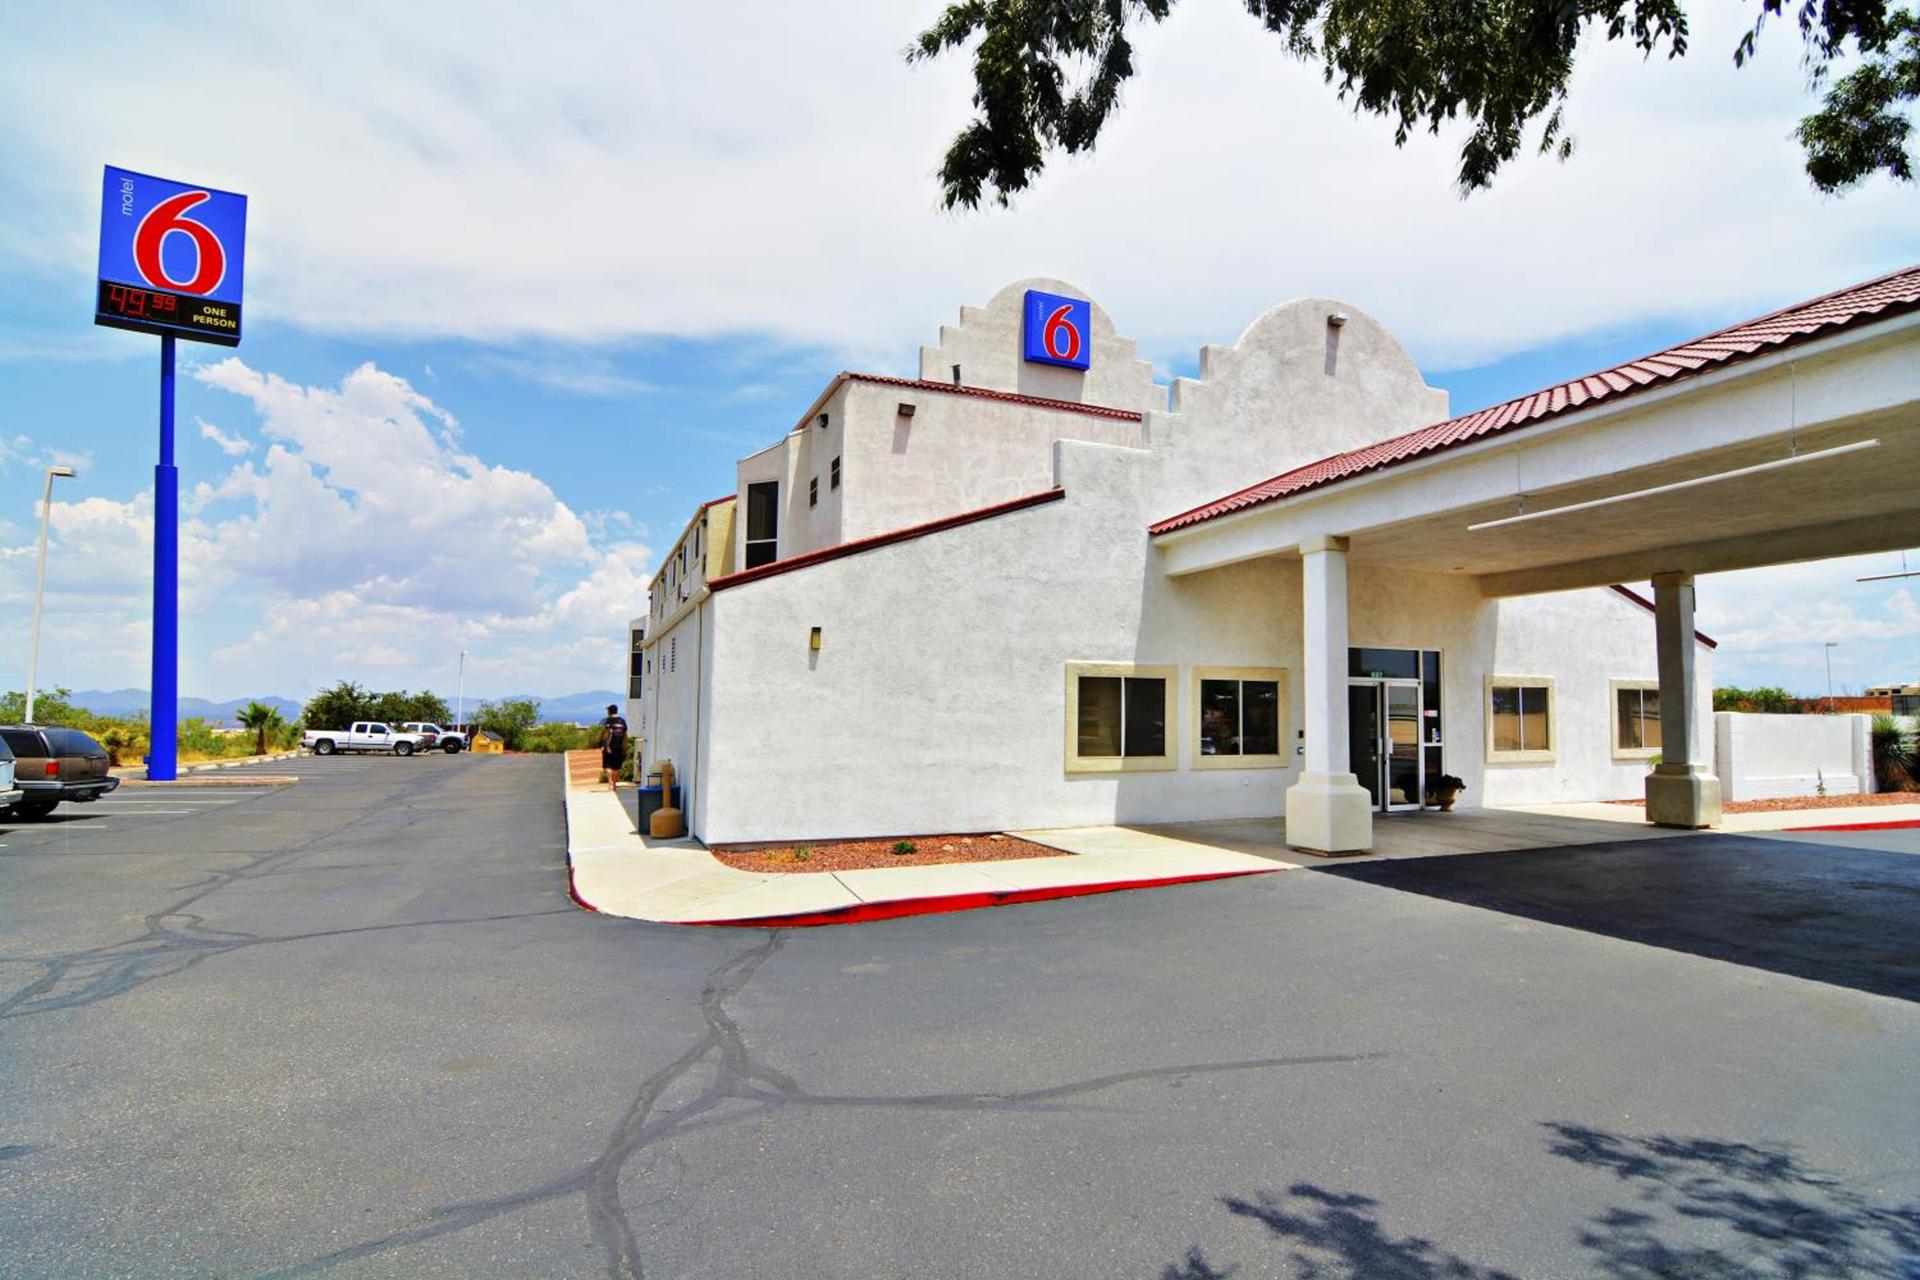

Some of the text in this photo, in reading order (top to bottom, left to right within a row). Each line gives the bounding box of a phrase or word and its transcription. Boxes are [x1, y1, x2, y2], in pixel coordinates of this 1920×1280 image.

[120, 178, 134, 216] motel
[133, 190, 227, 296] 6
[193, 314, 236, 328] PERSON
[203, 306, 227, 317] ONE
[1043, 304, 1081, 361] 6
